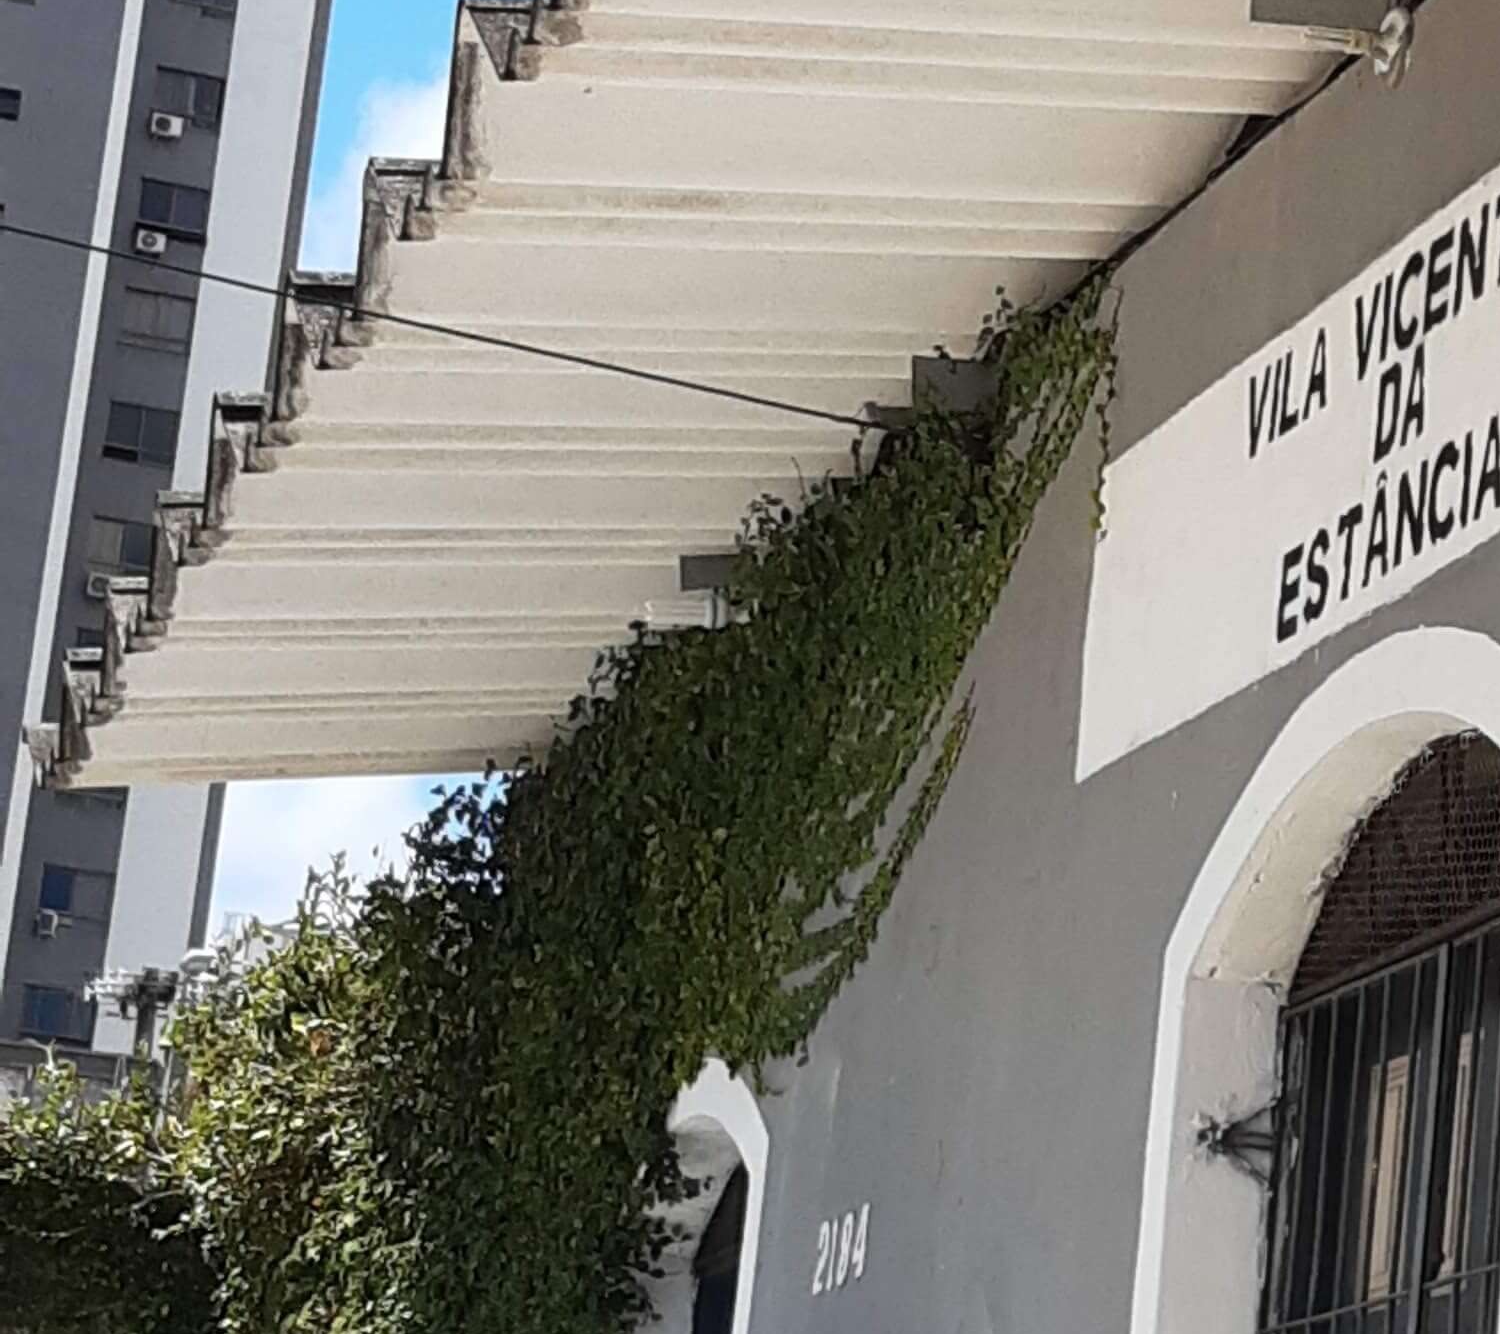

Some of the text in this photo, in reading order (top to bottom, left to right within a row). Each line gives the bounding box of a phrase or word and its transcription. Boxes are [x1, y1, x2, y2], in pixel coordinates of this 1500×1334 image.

[1248, 327, 1328, 460] VILA
[1372, 341, 1426, 465] DA
[811, 1202, 871, 1296] 2184
